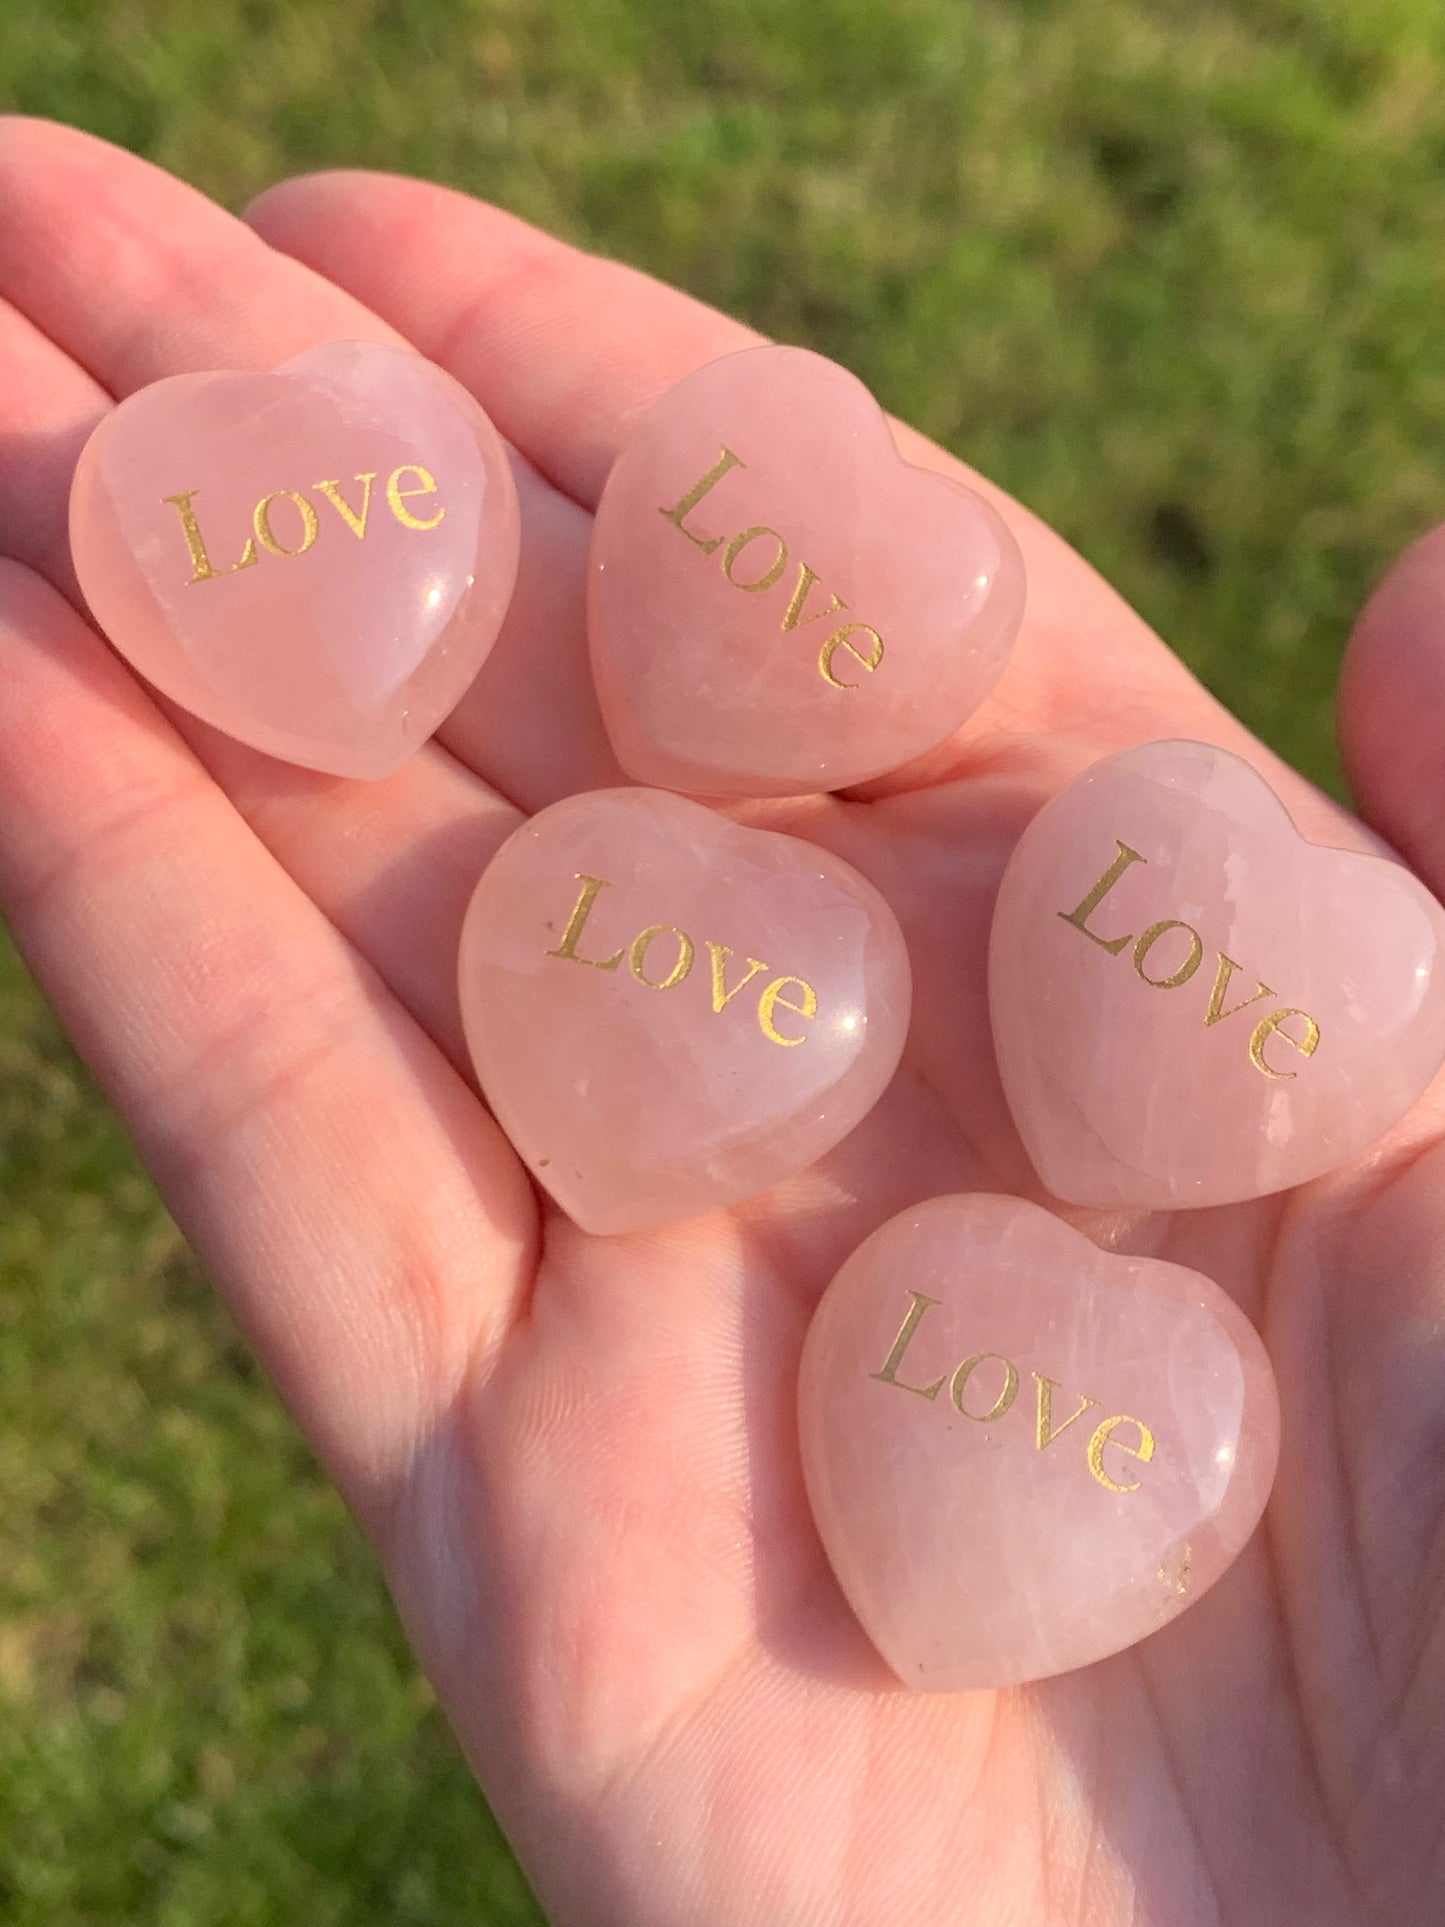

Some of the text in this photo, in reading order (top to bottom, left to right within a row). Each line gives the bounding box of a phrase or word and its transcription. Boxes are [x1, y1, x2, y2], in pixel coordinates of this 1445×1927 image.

[163, 463, 446, 587] Love
[658, 445, 885, 692] Love
[545, 872, 818, 1048] Love
[1057, 839, 1321, 1081] Love
[869, 1290, 1157, 1493] Love
